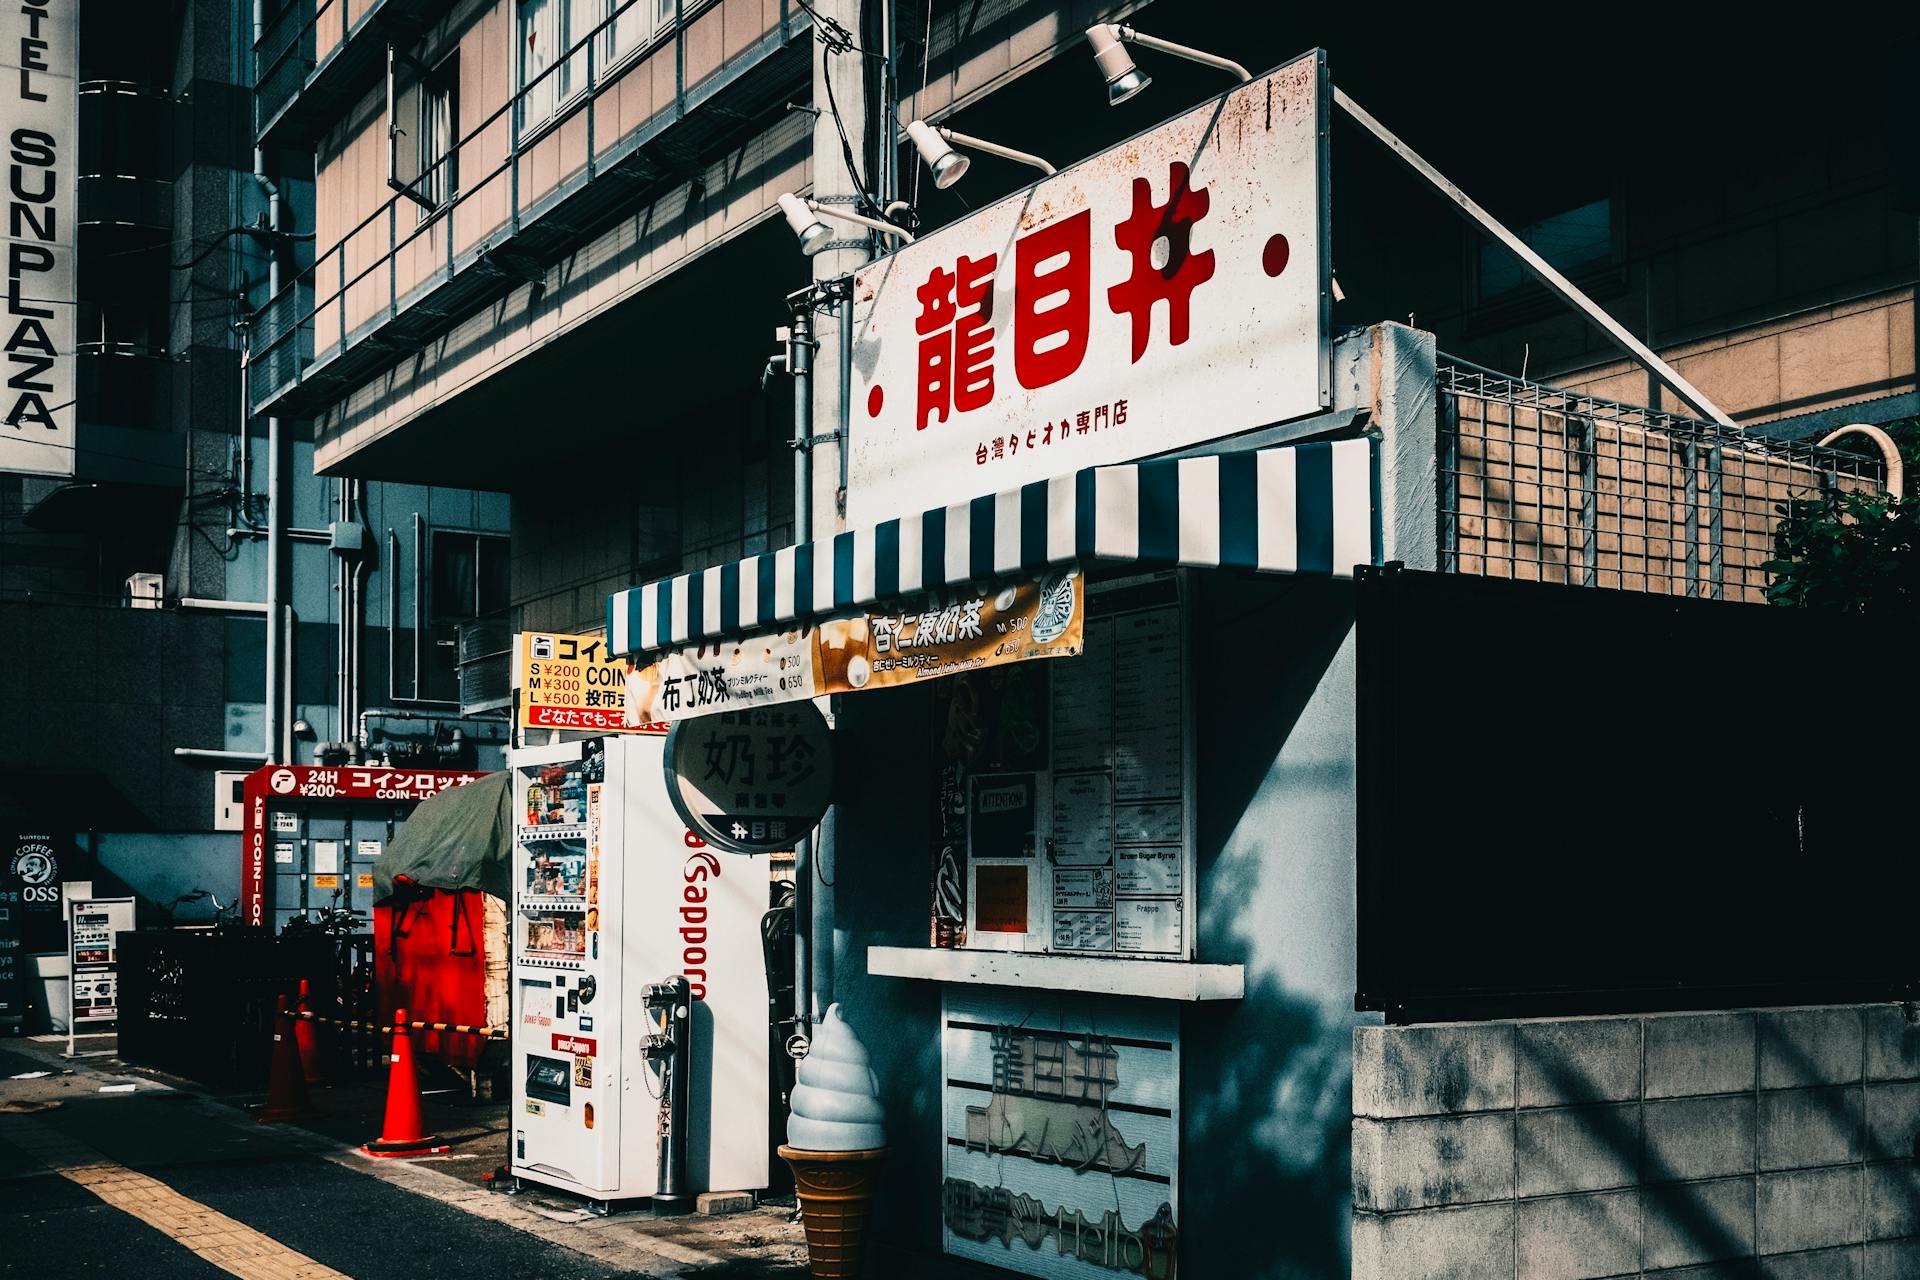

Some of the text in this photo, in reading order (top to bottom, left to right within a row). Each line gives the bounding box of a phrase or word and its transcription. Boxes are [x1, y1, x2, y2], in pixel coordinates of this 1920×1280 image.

[4, 0, 57, 430] TEL SUNPLAZA
[531, 663, 580, 678] S ¥200
[917, 666, 942, 677] Almond
[529, 678, 580, 691] M ¥300
[662, 666, 730, 711] 布丁奶茶
[788, 675, 803, 689] 650
[530, 691, 580, 705] L ¥500
[308, 770, 338, 783] 24H
[15, 844, 54, 857] COFFEE
[1136, 904, 1159, 914] Frappe
[679, 864, 710, 1001] sapporo
[1058, 1208, 1144, 1269] Hello
